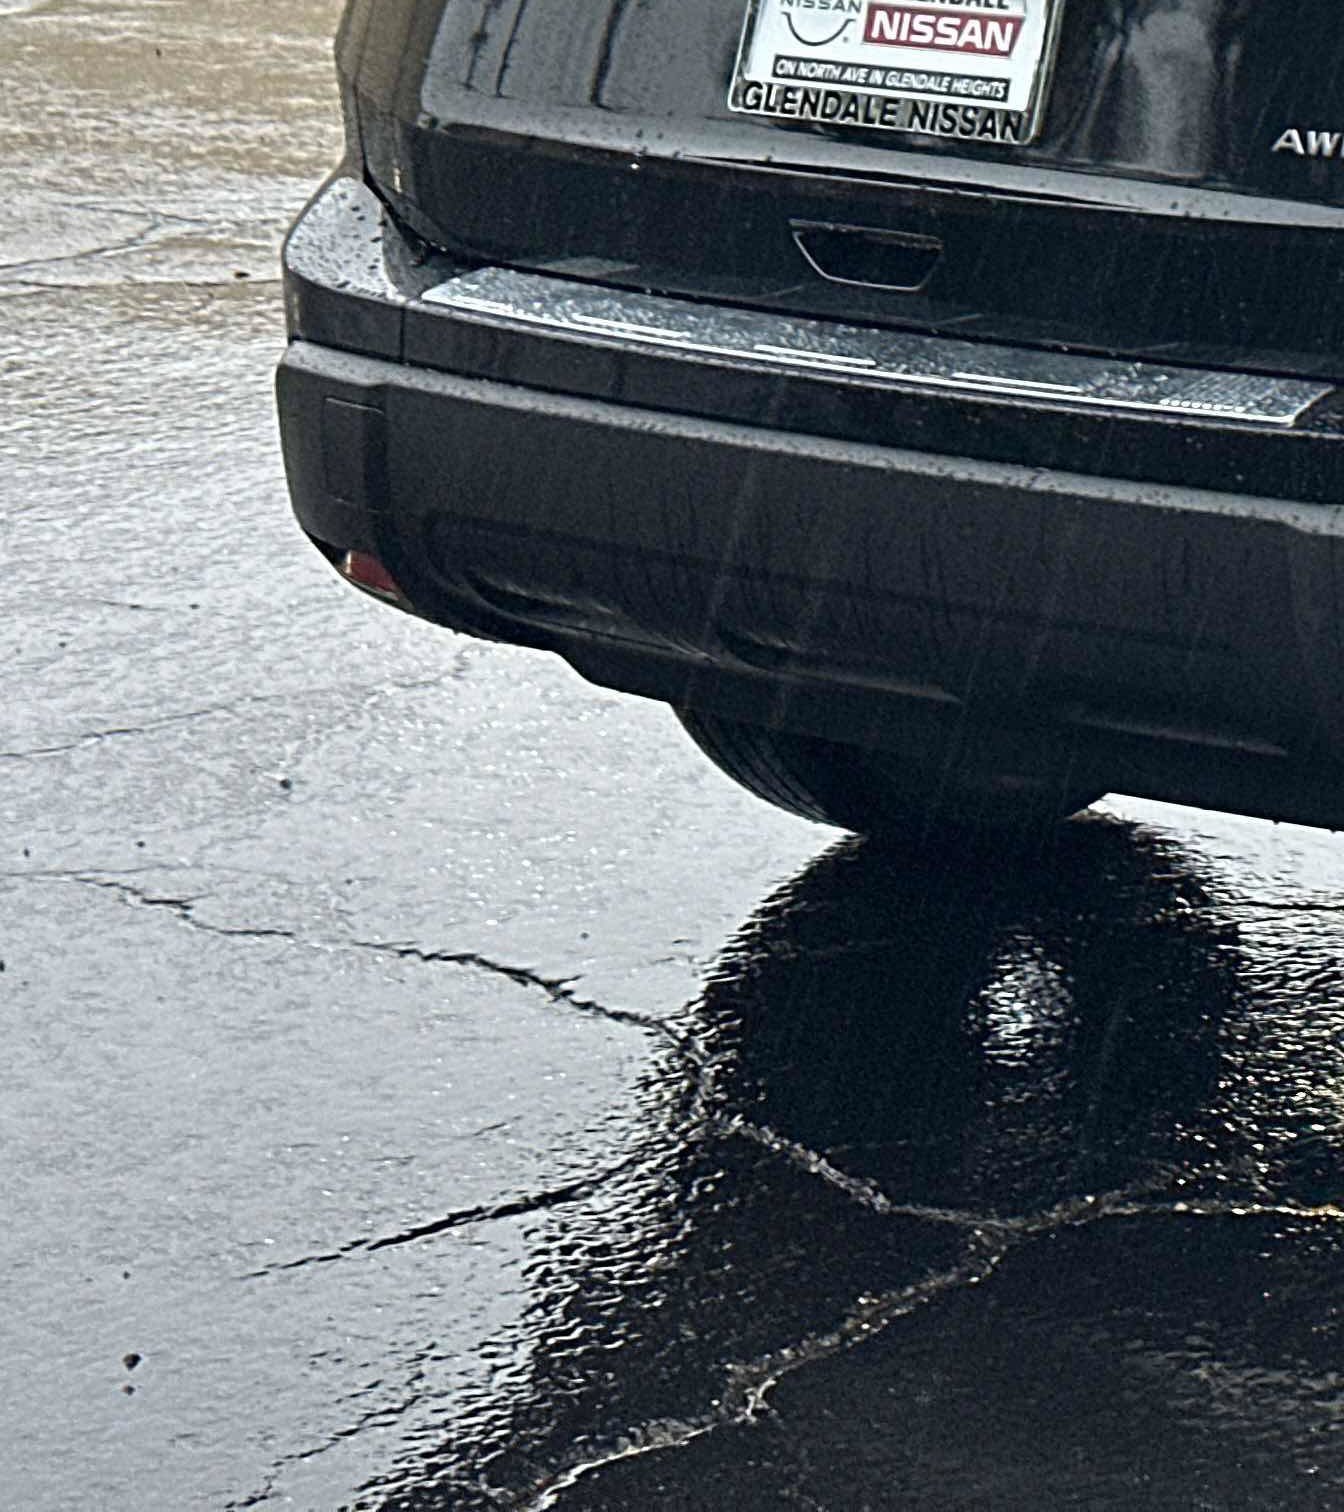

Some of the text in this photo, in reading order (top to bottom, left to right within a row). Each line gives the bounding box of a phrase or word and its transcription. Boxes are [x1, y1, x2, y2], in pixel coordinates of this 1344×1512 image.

[871, 14, 1014, 52] NISSAN
[775, 59, 1007, 99] ON NORTH AVE IN GLENDALE HEIGHTS
[742, 80, 1023, 142] GLENDALE NISSAN
